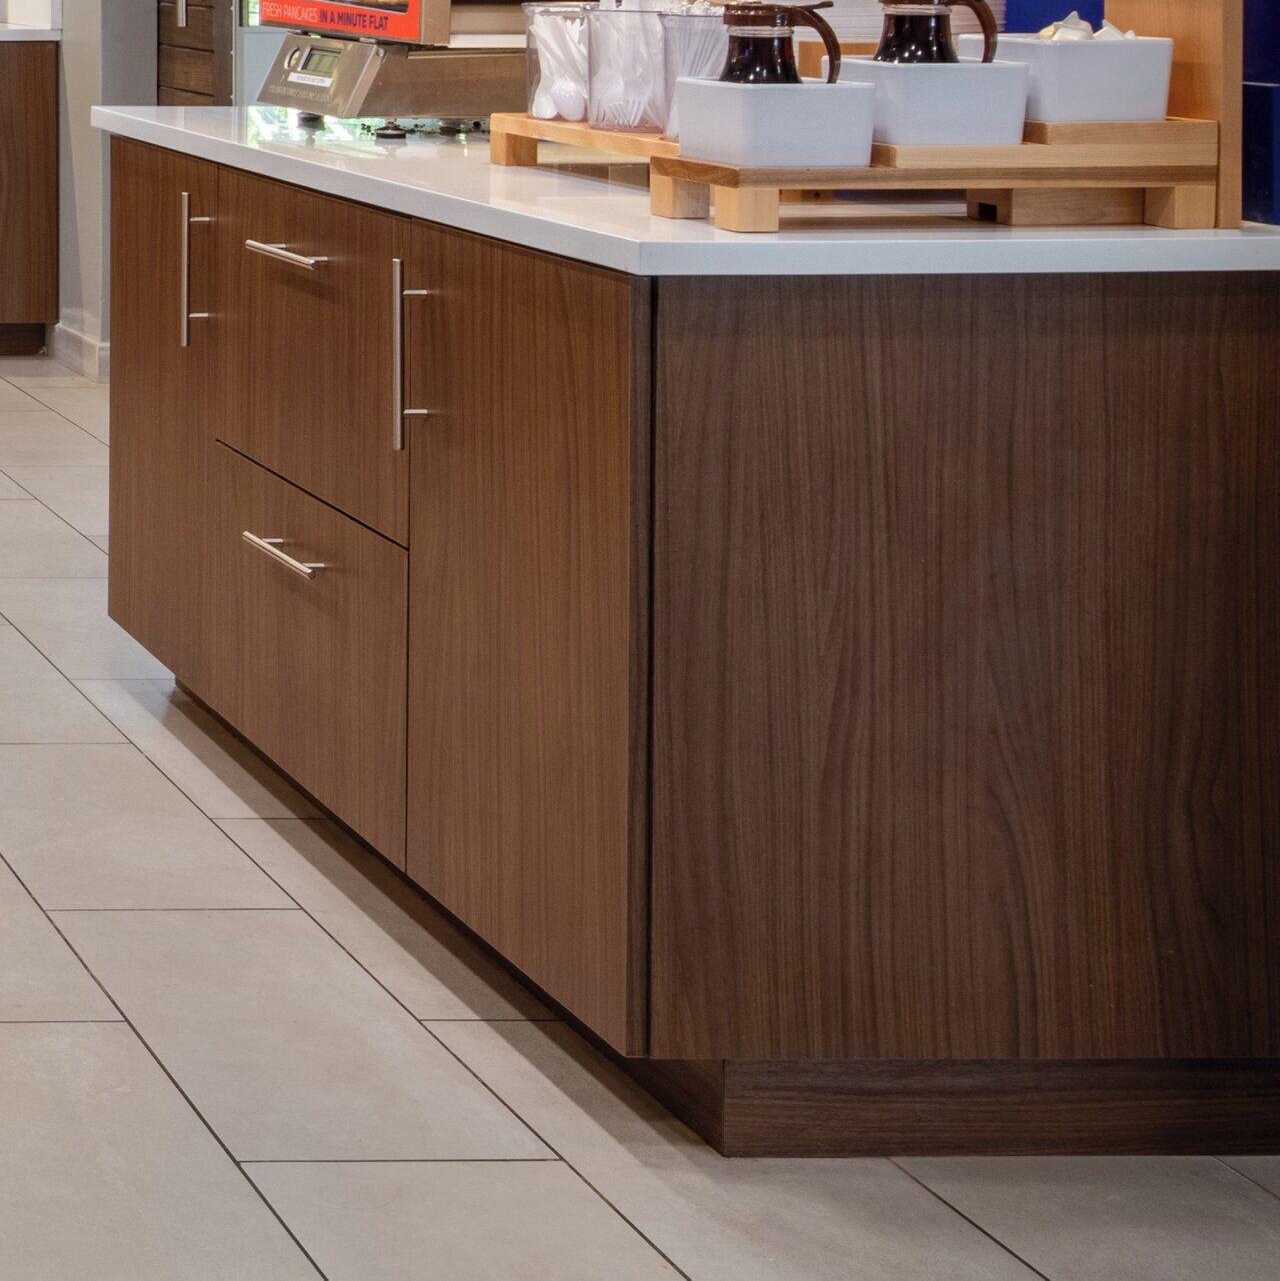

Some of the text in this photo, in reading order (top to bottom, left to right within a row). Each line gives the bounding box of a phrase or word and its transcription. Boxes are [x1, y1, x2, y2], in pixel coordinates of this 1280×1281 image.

[263, 2, 389, 31] FRESH PANCAKES IN A MINUTE FLAT
